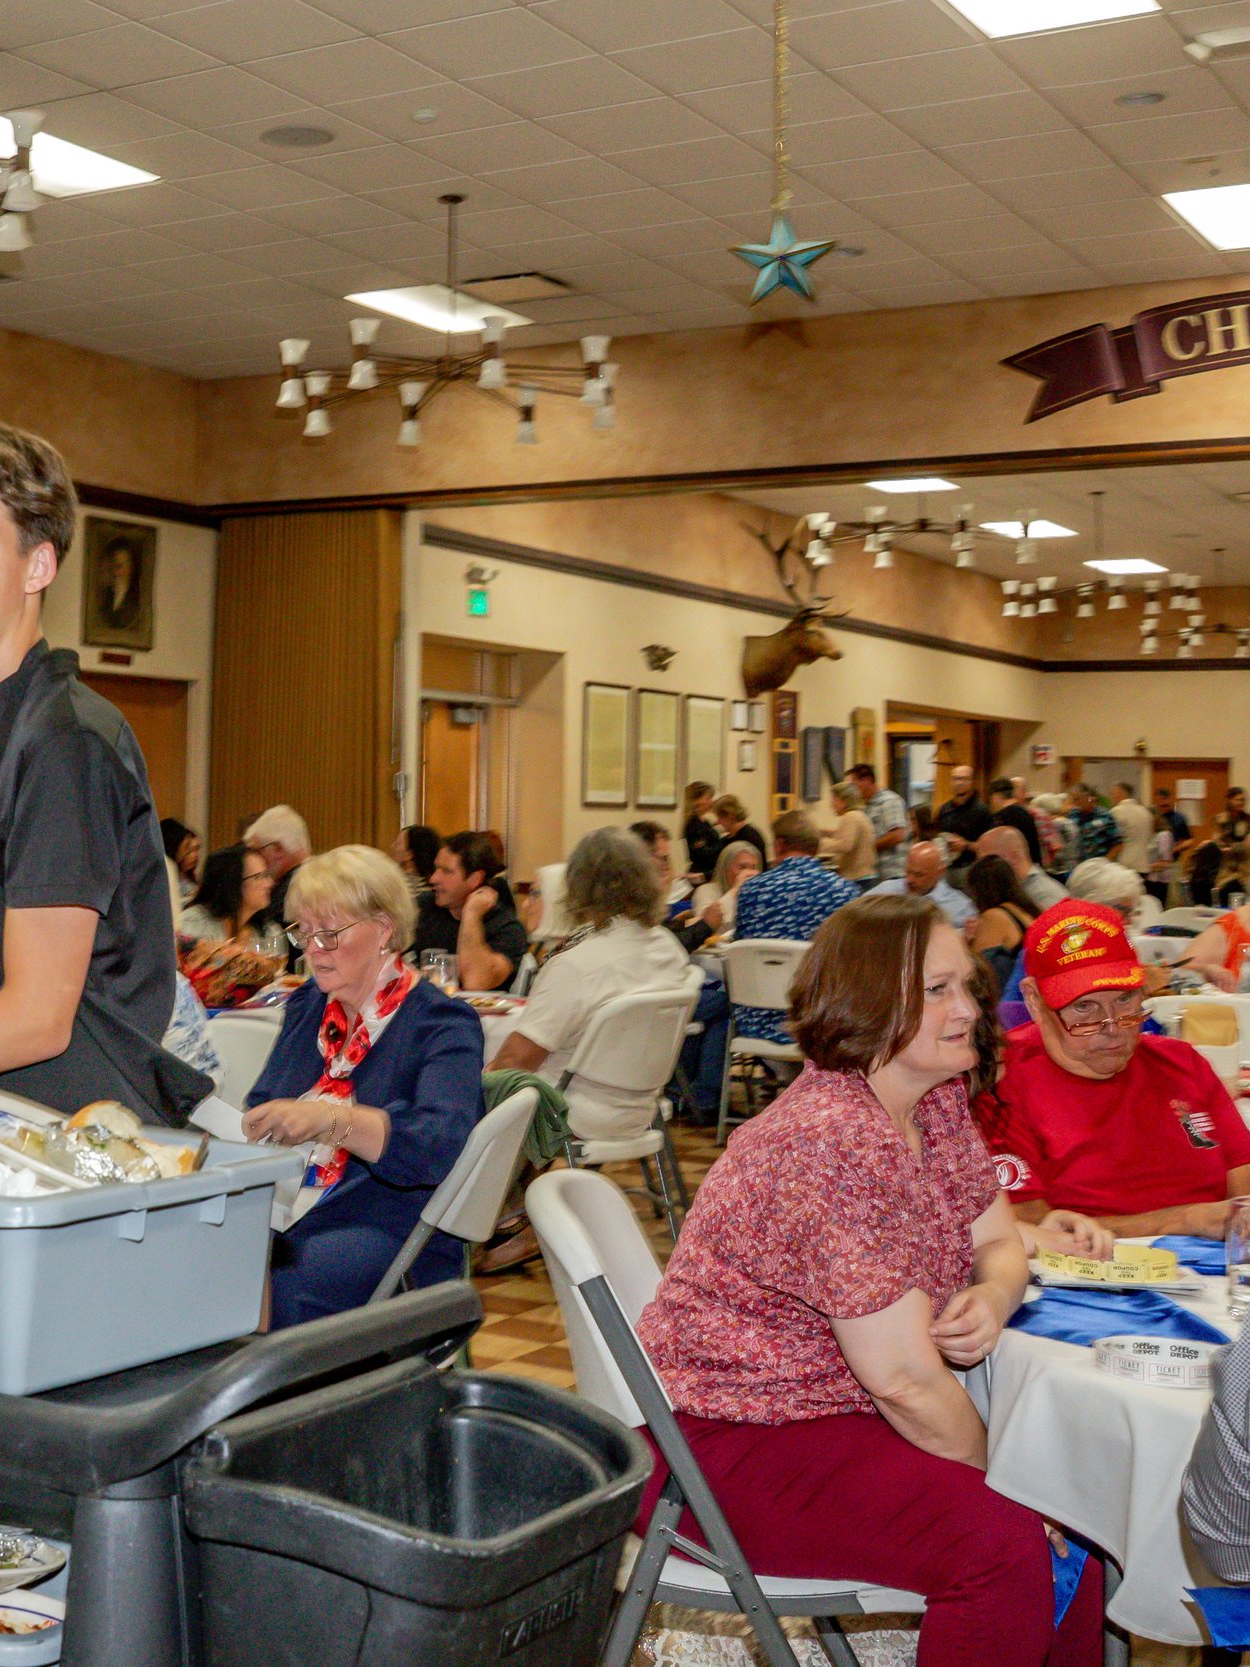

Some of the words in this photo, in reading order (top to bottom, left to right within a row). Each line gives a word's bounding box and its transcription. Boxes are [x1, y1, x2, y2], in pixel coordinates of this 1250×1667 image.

[1046, 916, 1087, 936] MARINE
[1085, 917, 1120, 938] CORPS
[1057, 948, 1106, 965] VETERAN
[1132, 1342, 1160, 1351] Office
[1170, 1345, 1199, 1356] Office
[1170, 1352, 1199, 1360] DEPOT
[1118, 1359, 1140, 1370] TICKET
[1156, 1366, 1181, 1375] TICKET
